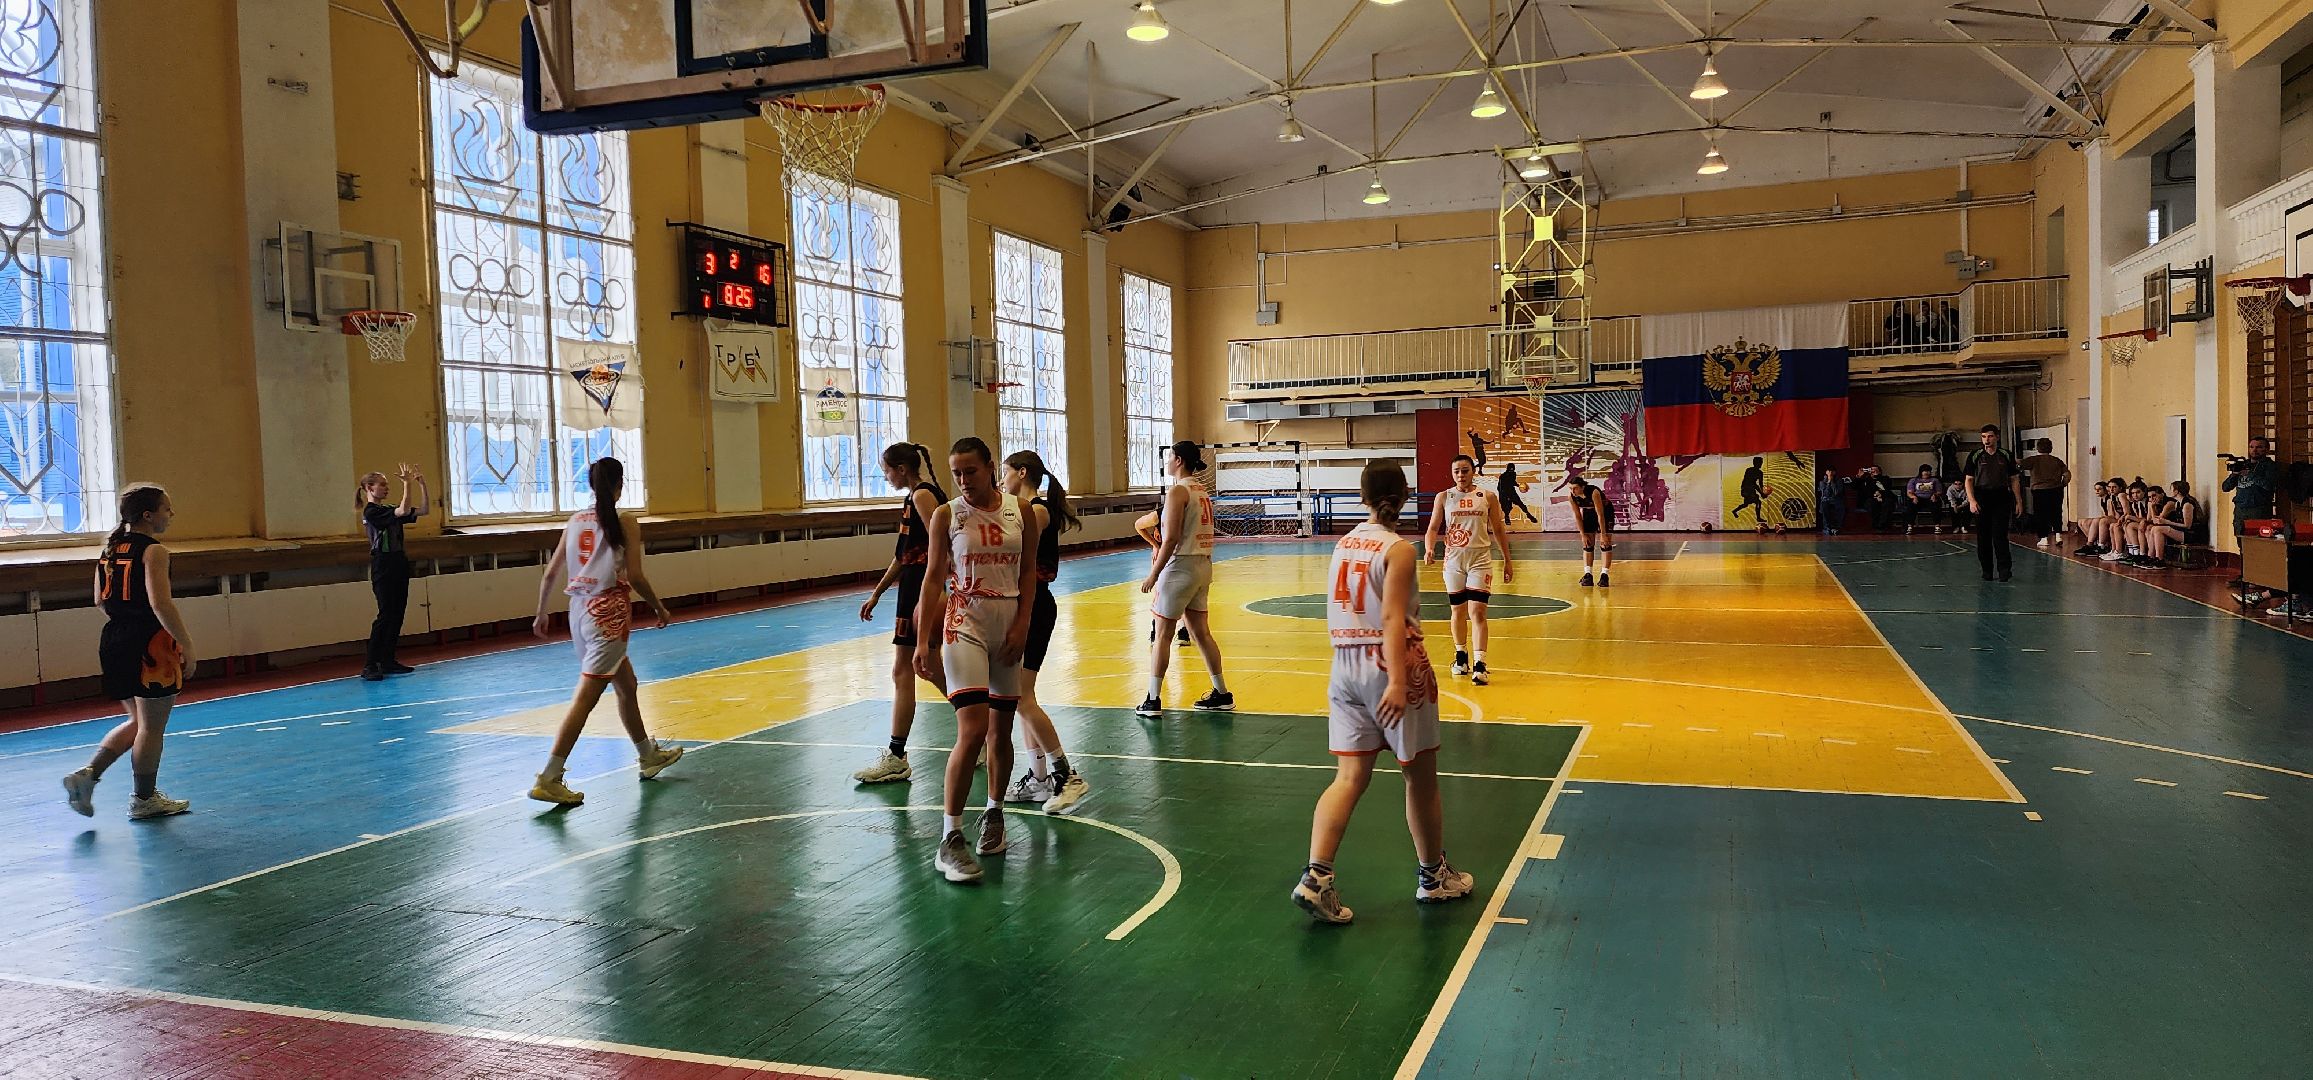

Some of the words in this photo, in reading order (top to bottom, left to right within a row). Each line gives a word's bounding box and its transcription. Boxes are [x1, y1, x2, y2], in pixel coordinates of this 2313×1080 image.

[705, 252, 716, 275] 3
[730, 252, 739, 270] 2
[759, 263, 771, 286] 16
[704, 294, 711, 309] 1
[1459, 499, 1473, 508] 88
[977, 523, 1004, 547] 18
[1332, 559, 1370, 614] 47
